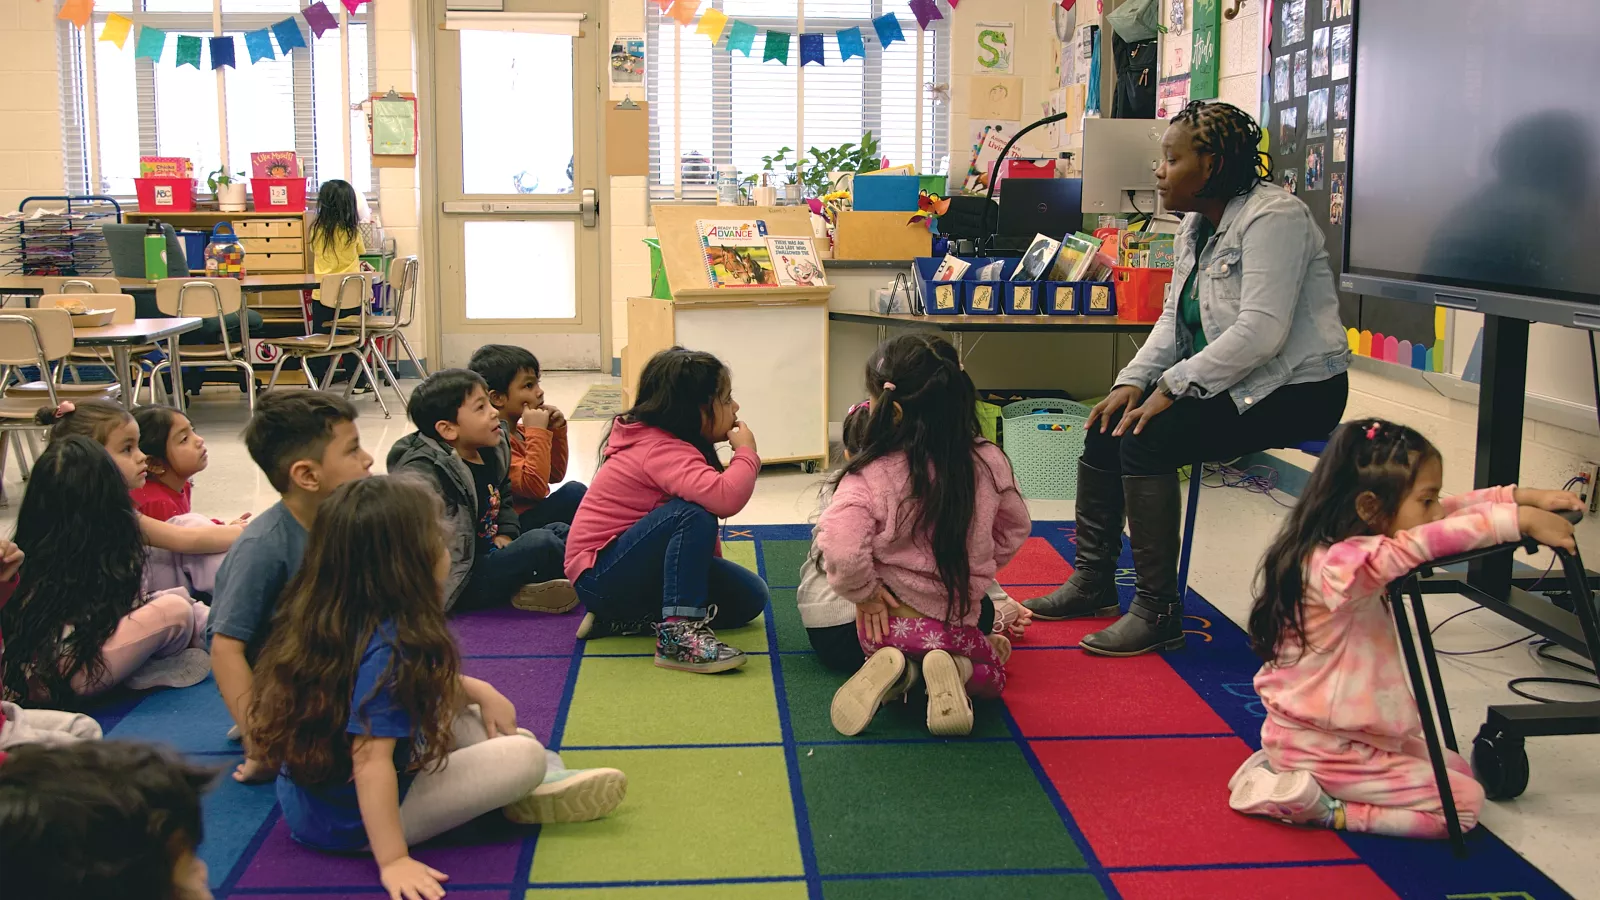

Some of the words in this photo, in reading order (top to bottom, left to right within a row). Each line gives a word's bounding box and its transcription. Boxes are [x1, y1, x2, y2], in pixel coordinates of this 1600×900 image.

[257, 153, 270, 162] Like
[271, 152, 293, 161] Myself!
[157, 189, 171, 198] ABC
[707, 226, 752, 237] ADVANCE
[1155, 251, 1164, 259] Life
[938, 287, 952, 308] Monday
[974, 288, 989, 307] Tuesday
[1092, 288, 1106, 308] Friday
